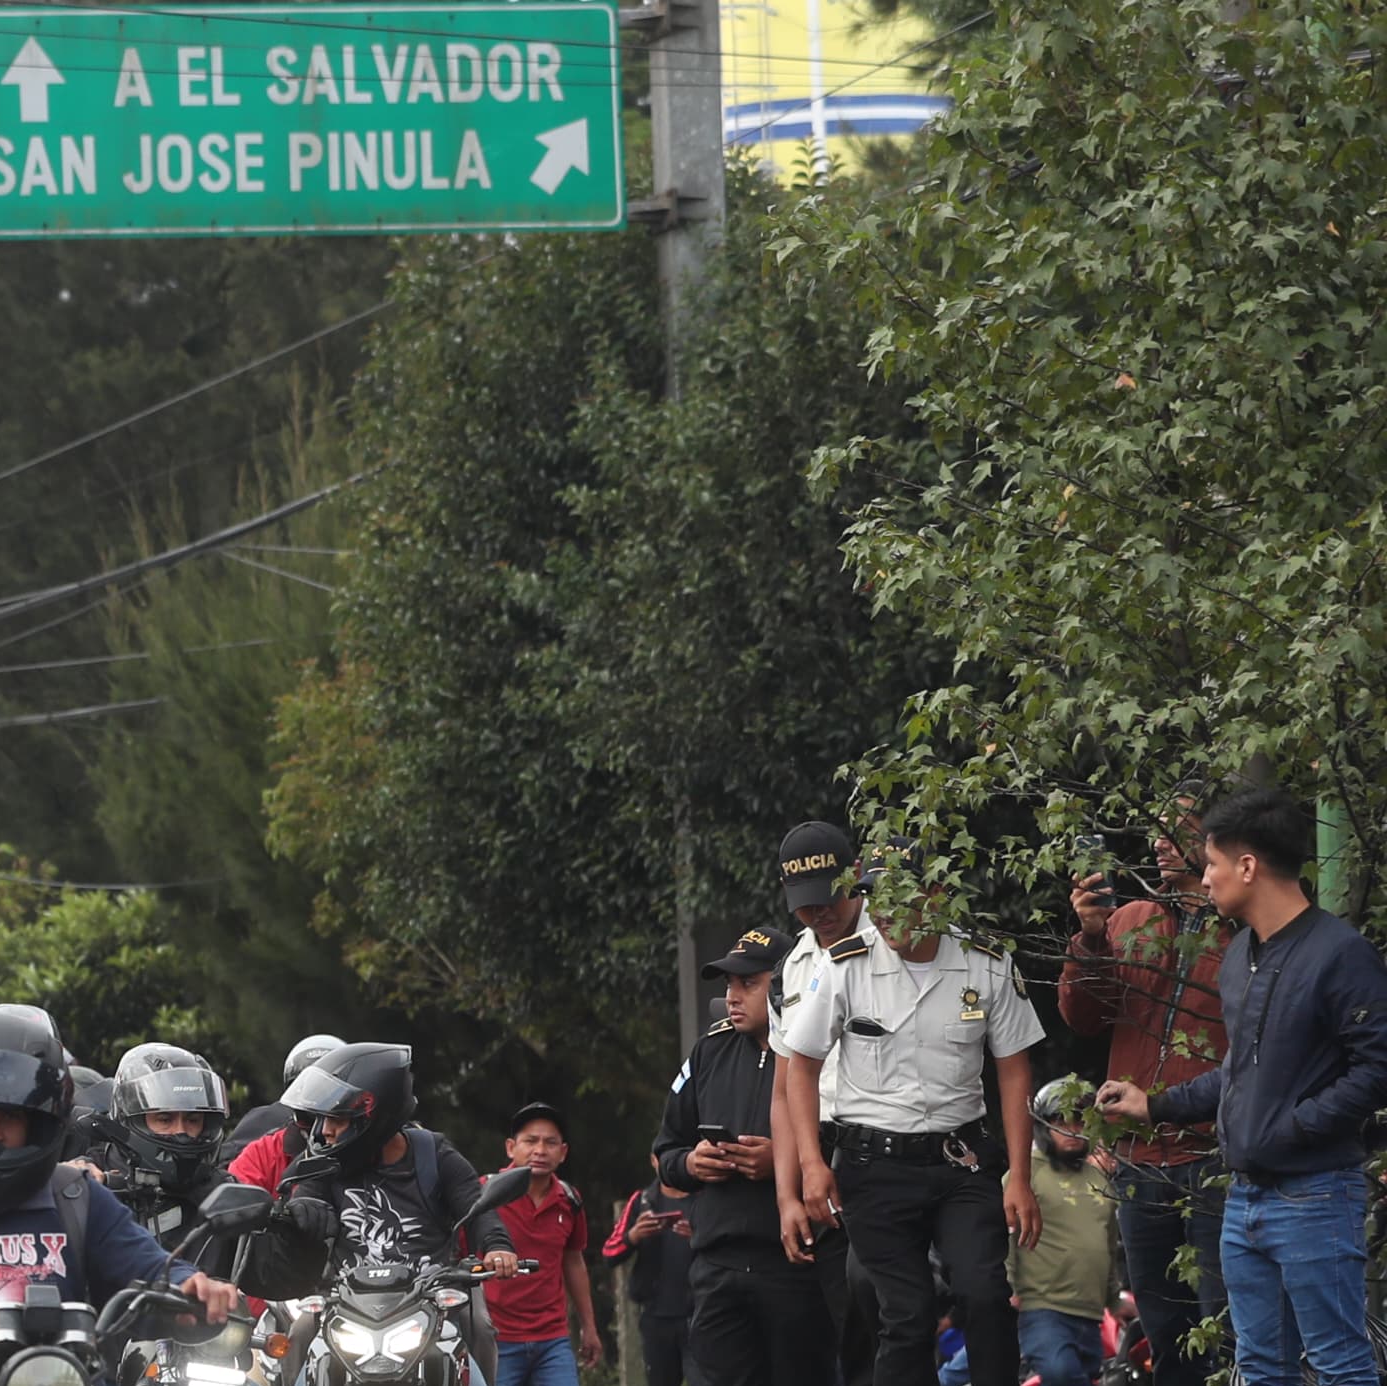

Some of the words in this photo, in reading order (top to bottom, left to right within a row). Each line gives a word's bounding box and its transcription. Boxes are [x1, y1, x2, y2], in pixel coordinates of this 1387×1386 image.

[113, 46, 154, 108] A
[177, 46, 242, 107] EL
[264, 43, 565, 106] SALVADOR
[122, 132, 266, 194] JOSE
[289, 129, 492, 192] PINULA
[781, 852, 838, 877] POLICIA
[39, 1232, 68, 1279] X
[368, 1268, 391, 1278] TVS
